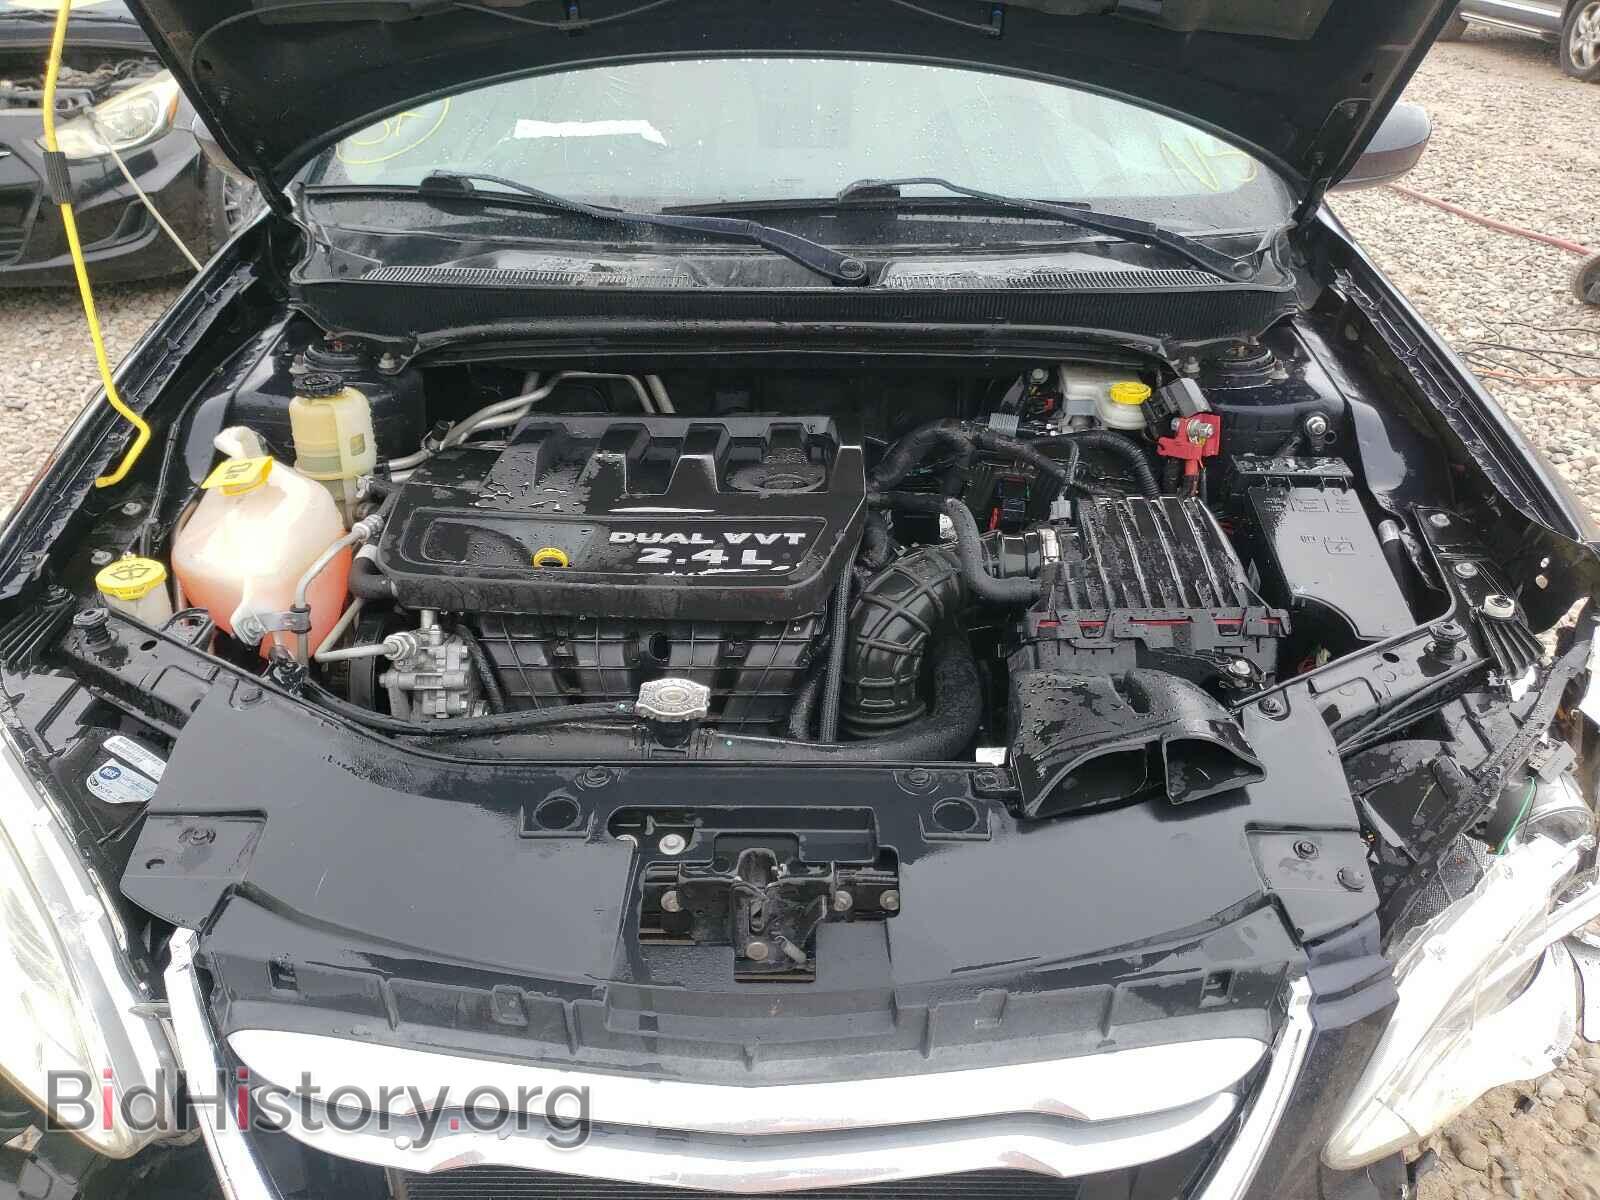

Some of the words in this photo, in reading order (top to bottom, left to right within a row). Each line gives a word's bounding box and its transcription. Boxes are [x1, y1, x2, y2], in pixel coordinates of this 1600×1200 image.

[609, 531, 714, 545] DUAL
[722, 532, 806, 546] VVT
[636, 547, 729, 565] 2.4
